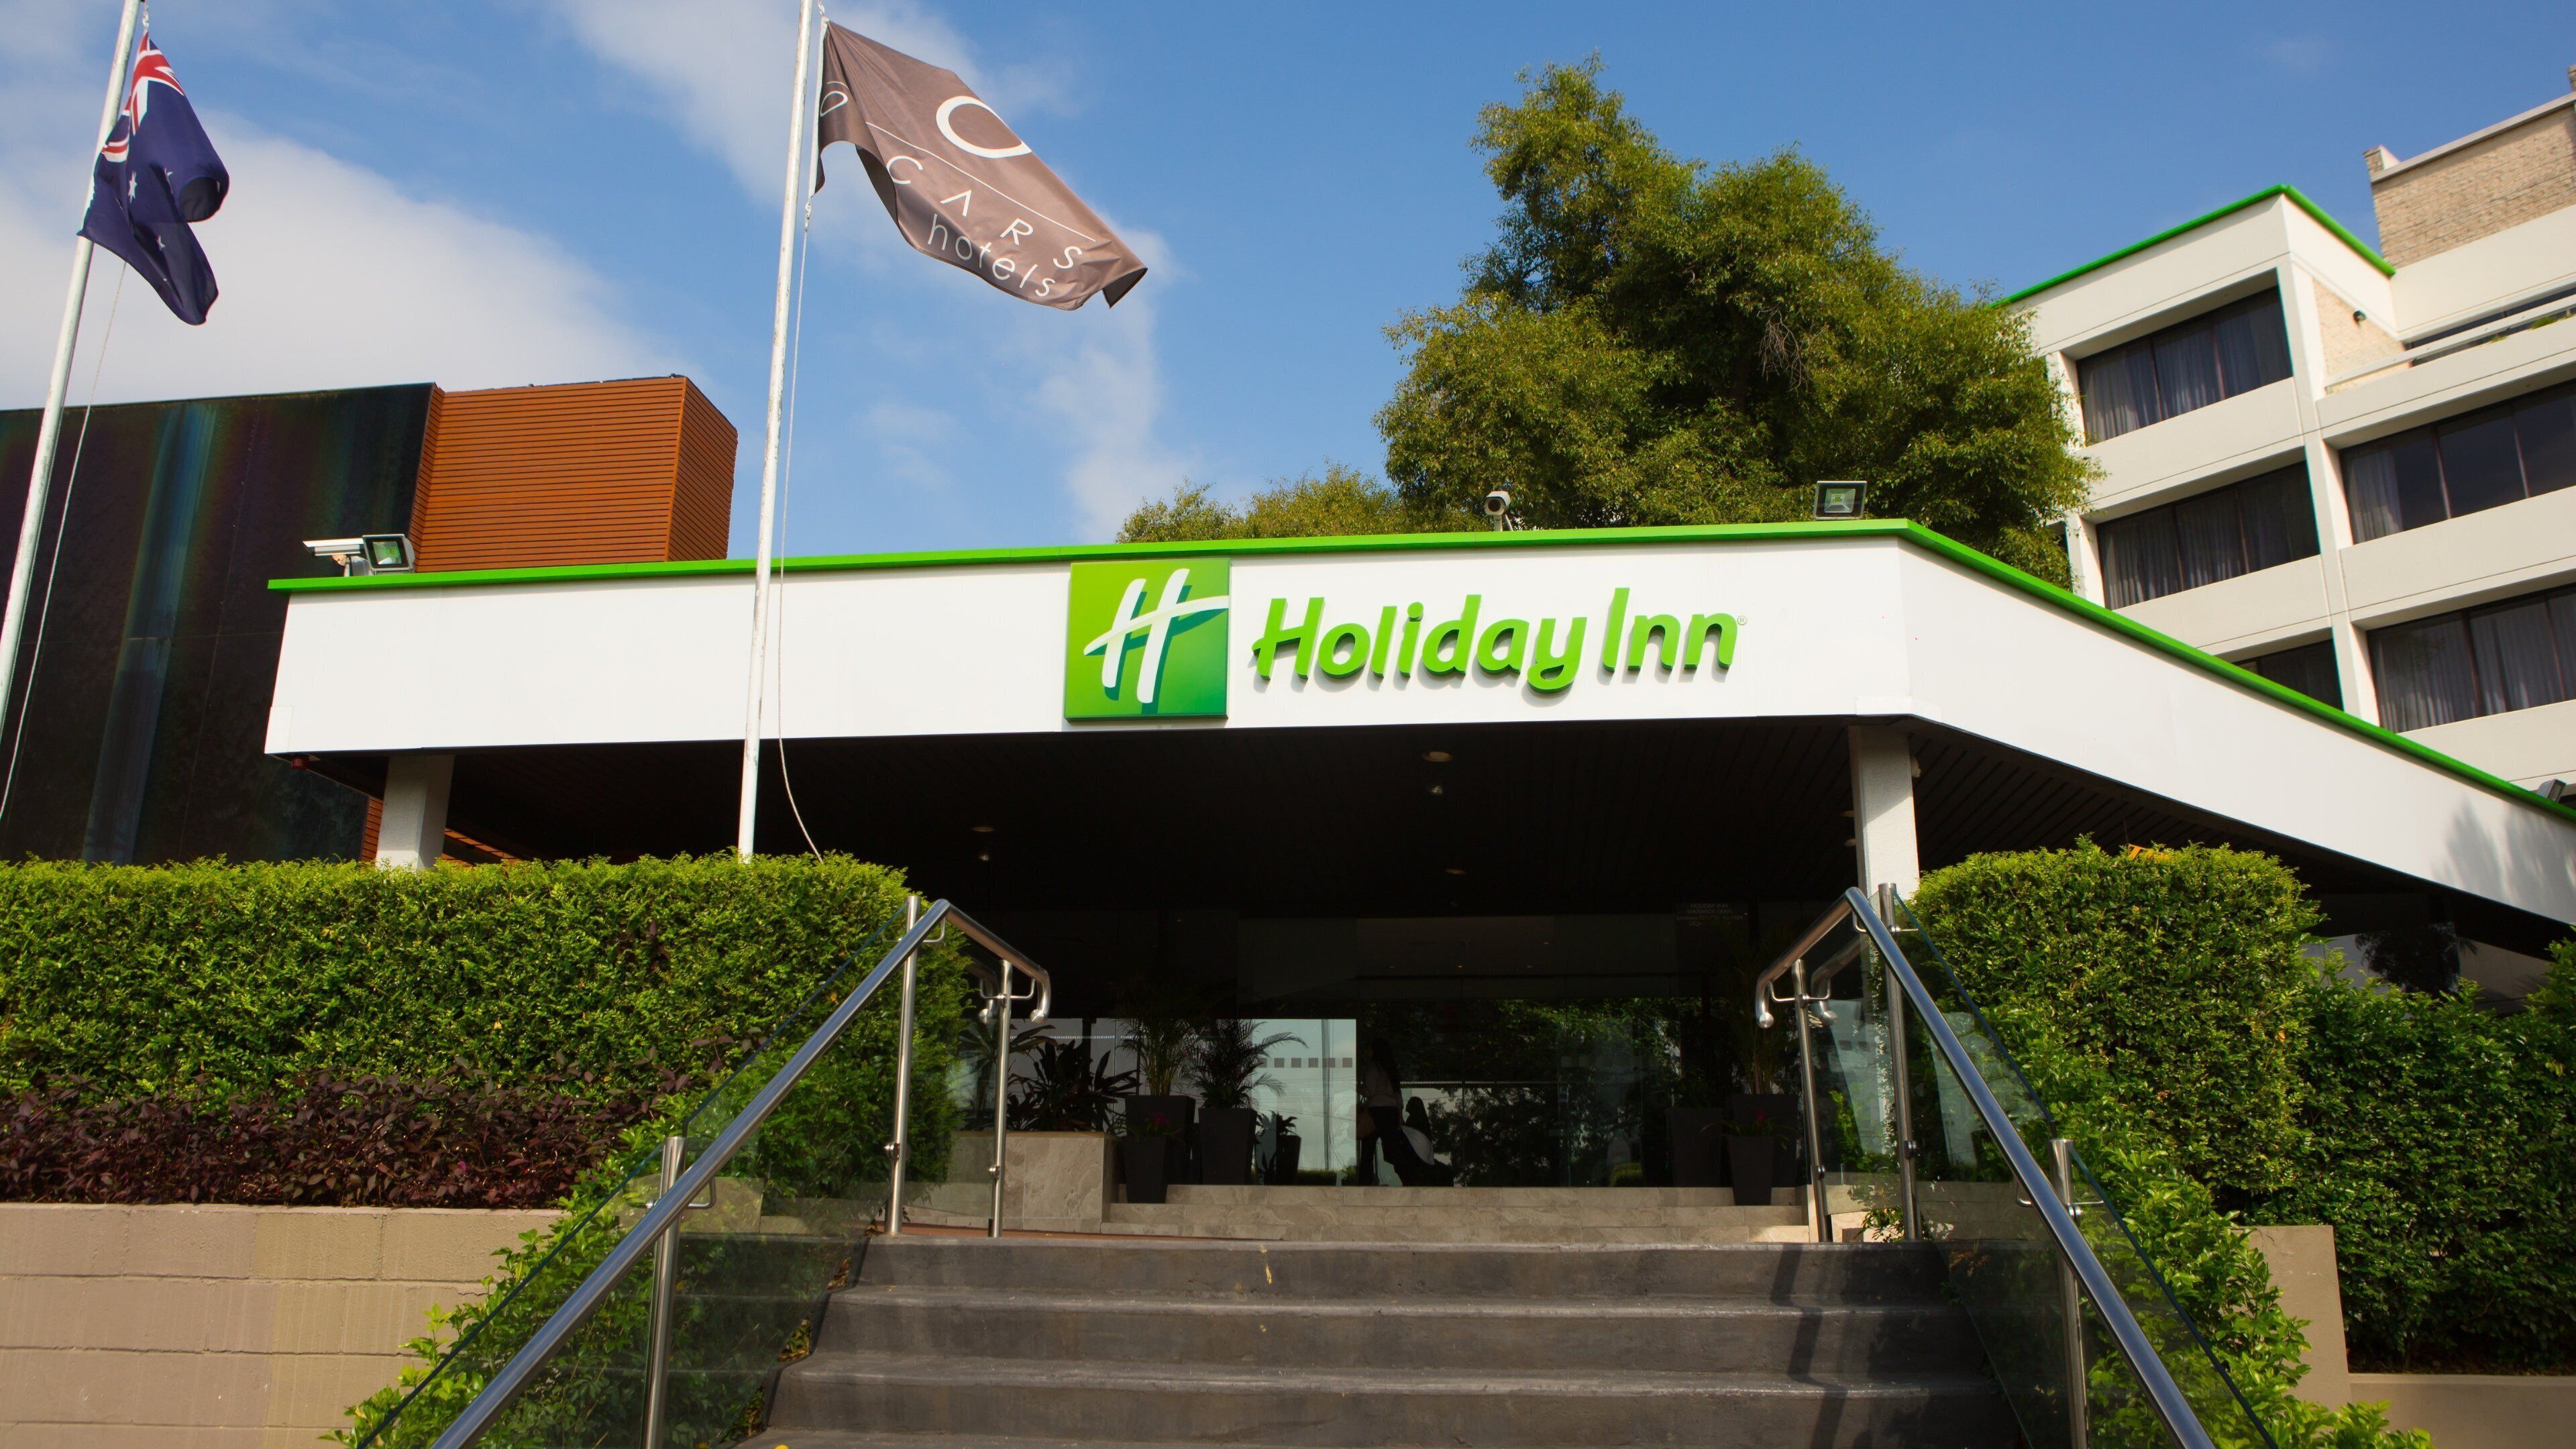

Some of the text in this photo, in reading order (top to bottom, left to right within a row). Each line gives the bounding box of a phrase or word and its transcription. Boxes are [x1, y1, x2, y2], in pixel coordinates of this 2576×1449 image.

[928, 214, 1055, 297] hotels
[1252, 588, 1737, 694] Holiday Inn
